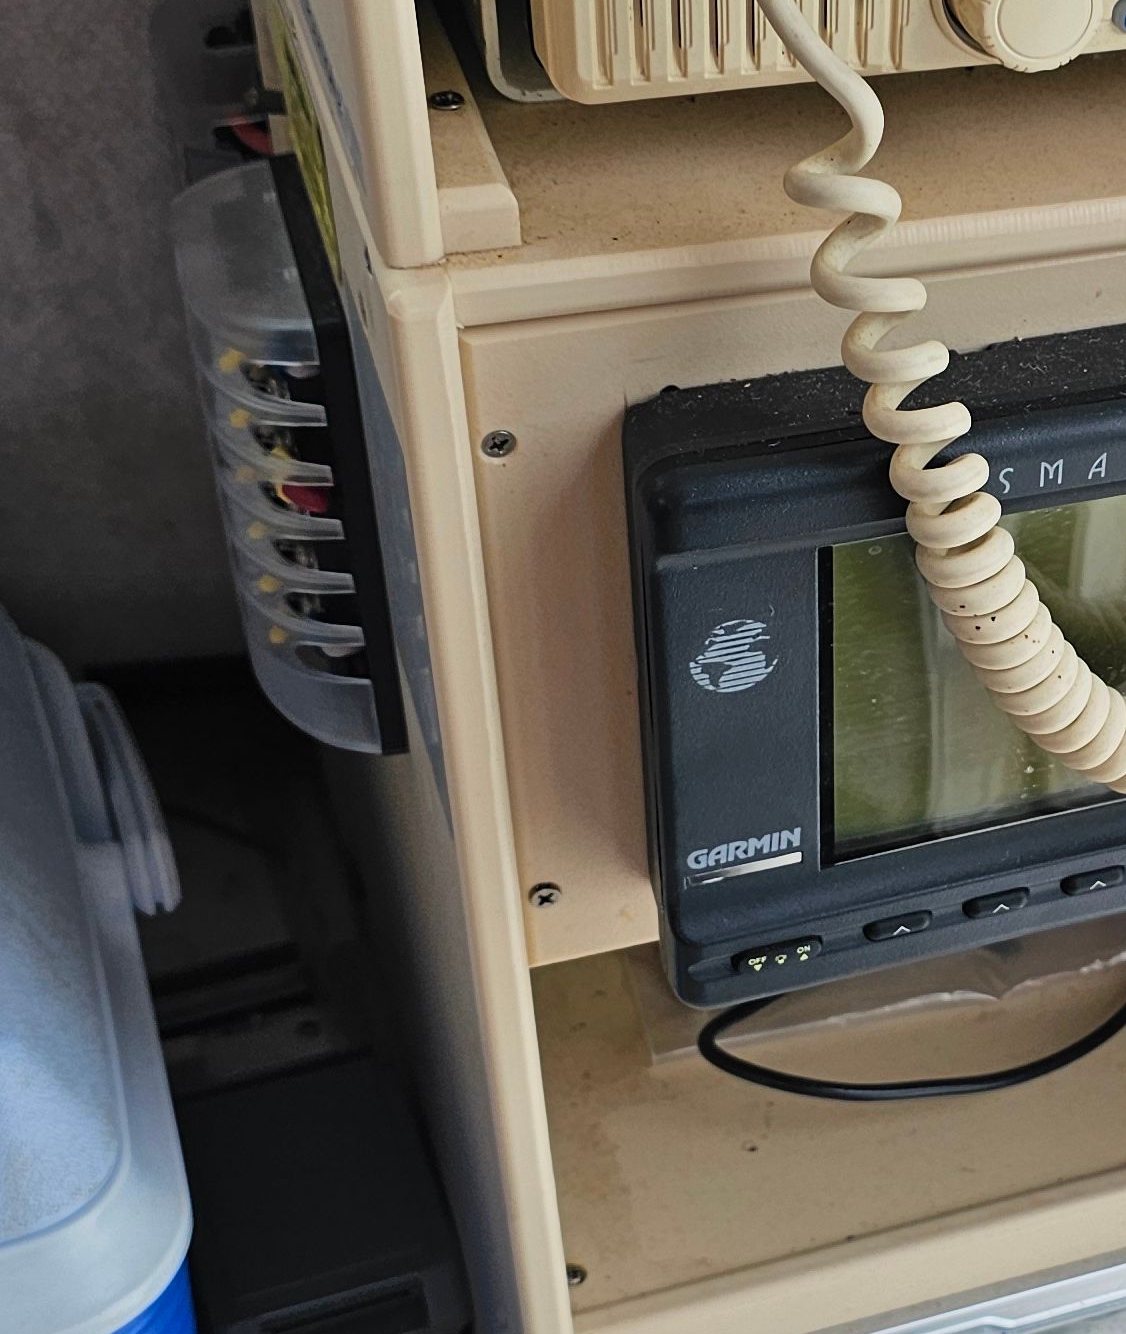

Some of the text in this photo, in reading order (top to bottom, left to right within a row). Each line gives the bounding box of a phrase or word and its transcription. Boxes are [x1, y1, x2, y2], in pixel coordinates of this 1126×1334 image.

[686, 826, 802, 870] GARMIN
[796, 944, 811, 954] ON
[748, 955, 767, 966] OFF
